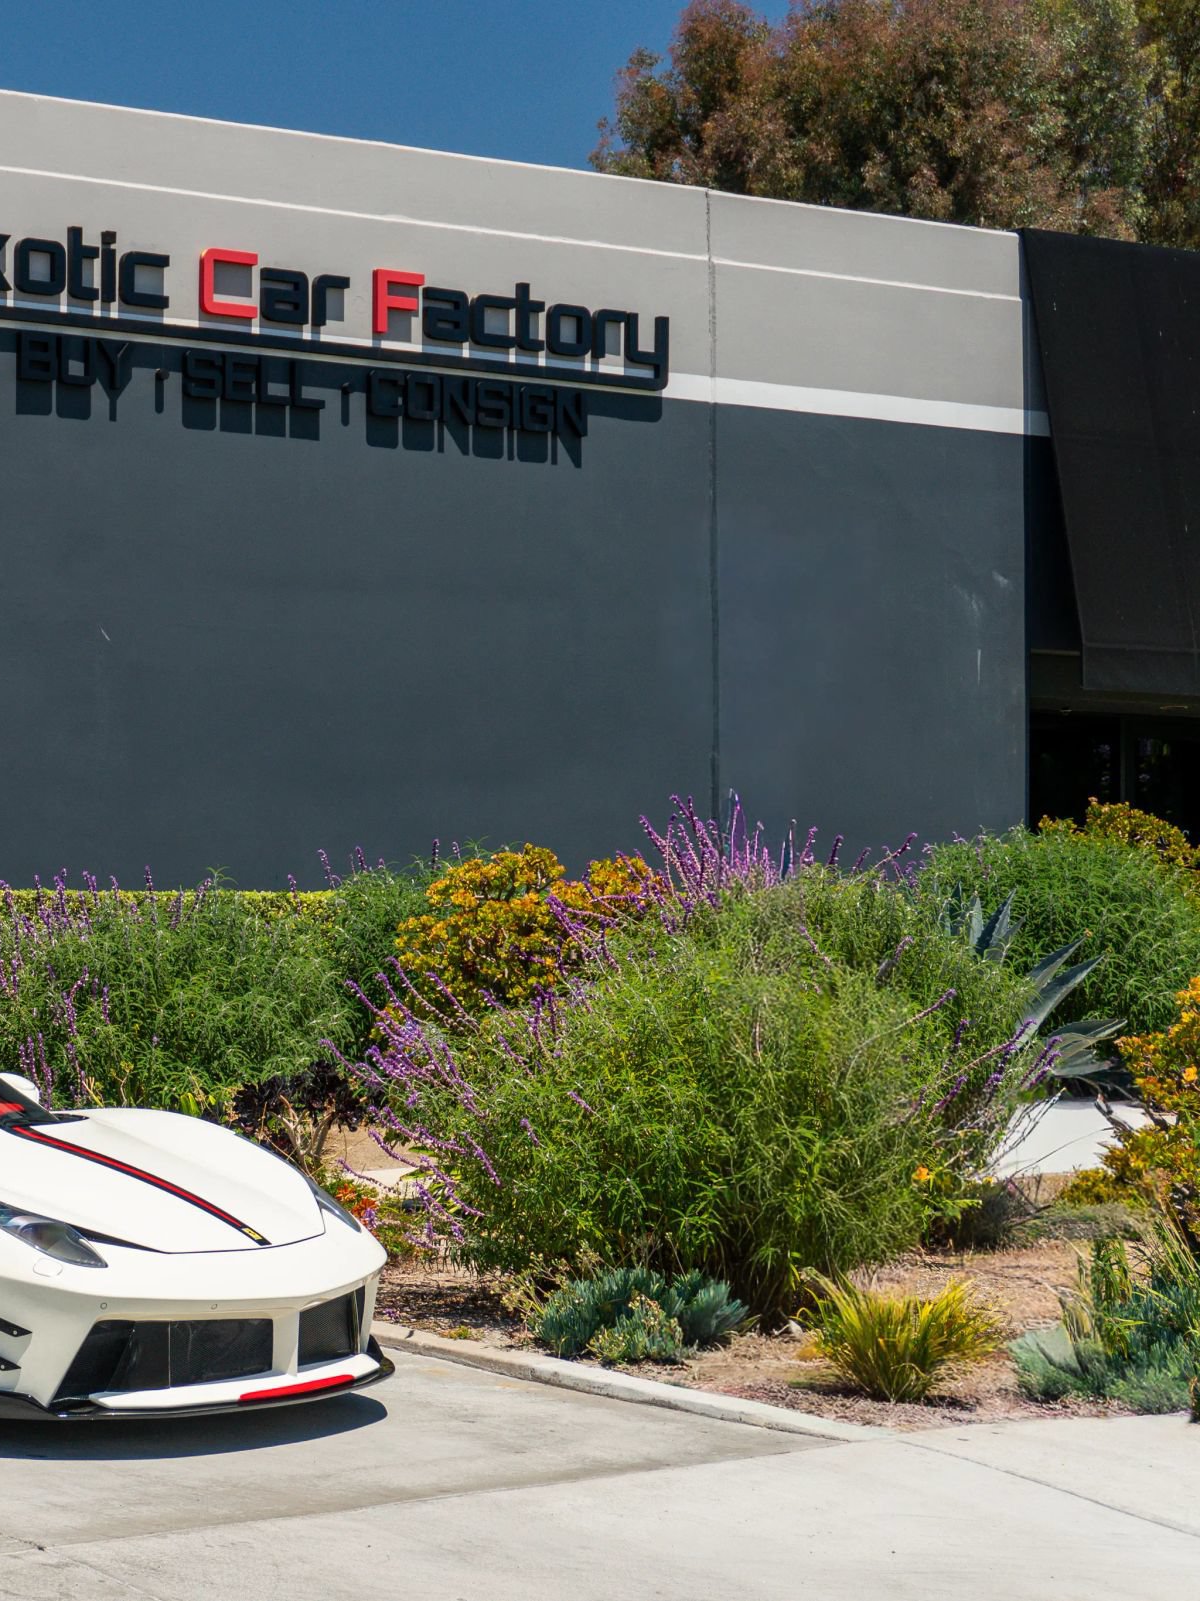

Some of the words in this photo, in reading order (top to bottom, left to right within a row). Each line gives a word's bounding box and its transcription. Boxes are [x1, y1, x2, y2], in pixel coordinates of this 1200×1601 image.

[200, 247, 351, 327] Car
[372, 268, 670, 391] Factory
[15, 331, 130, 389] BUY
[182, 349, 326, 410] SELL
[367, 369, 588, 437] CONSIGN
